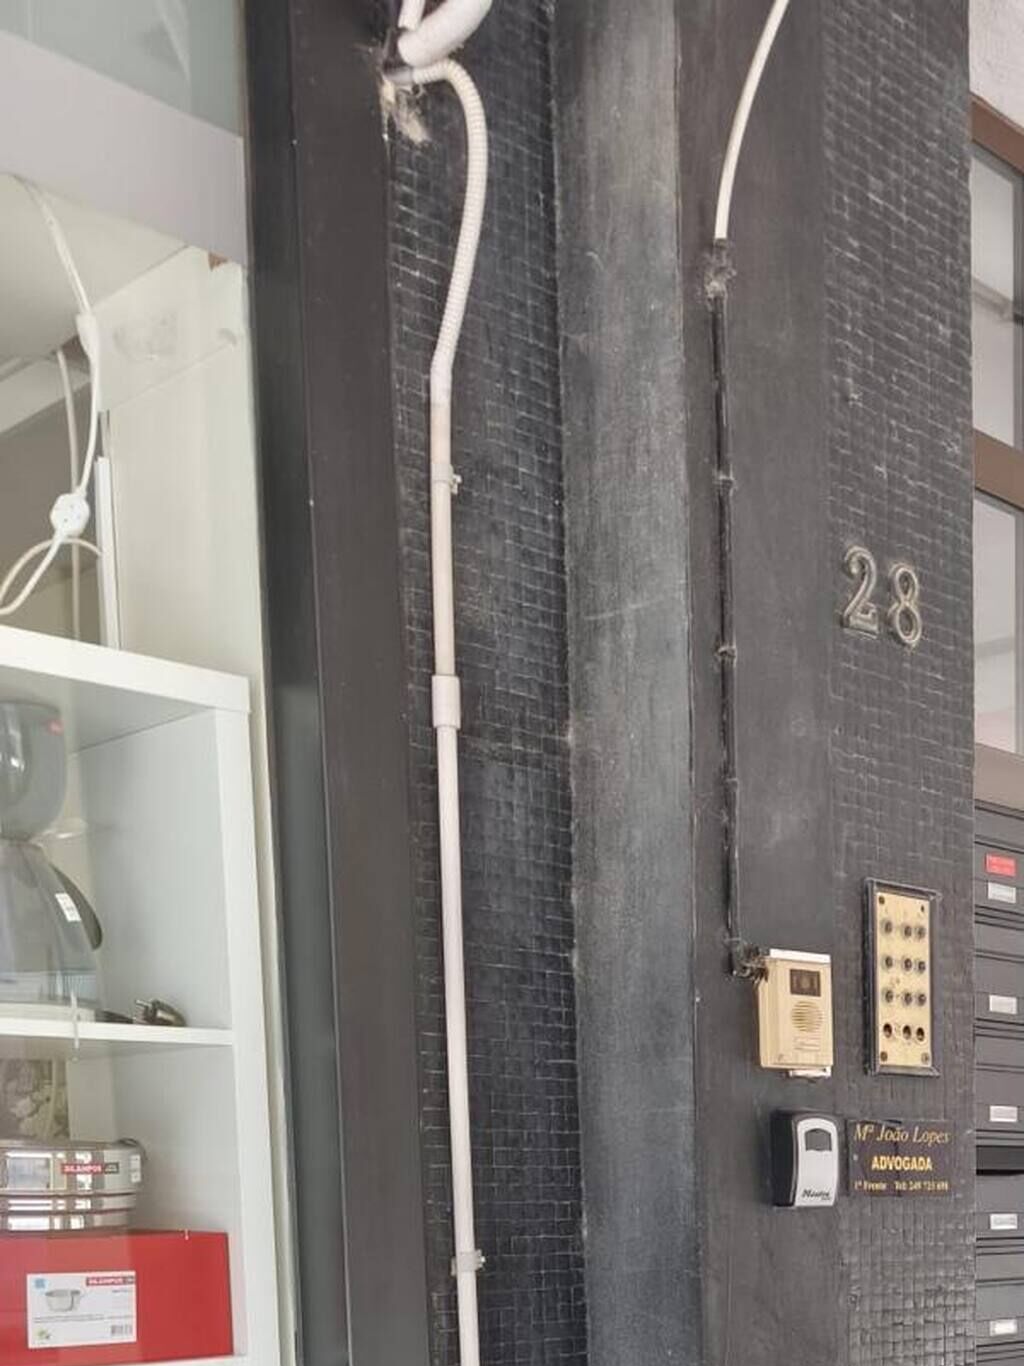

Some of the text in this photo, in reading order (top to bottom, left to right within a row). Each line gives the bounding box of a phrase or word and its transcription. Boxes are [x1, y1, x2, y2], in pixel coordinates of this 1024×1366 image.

[841, 545, 921, 643] 28
[877, 1124, 909, 1143] João
[912, 1125, 951, 1148] Lopes
[871, 1155, 933, 1171] ADVOGADA
